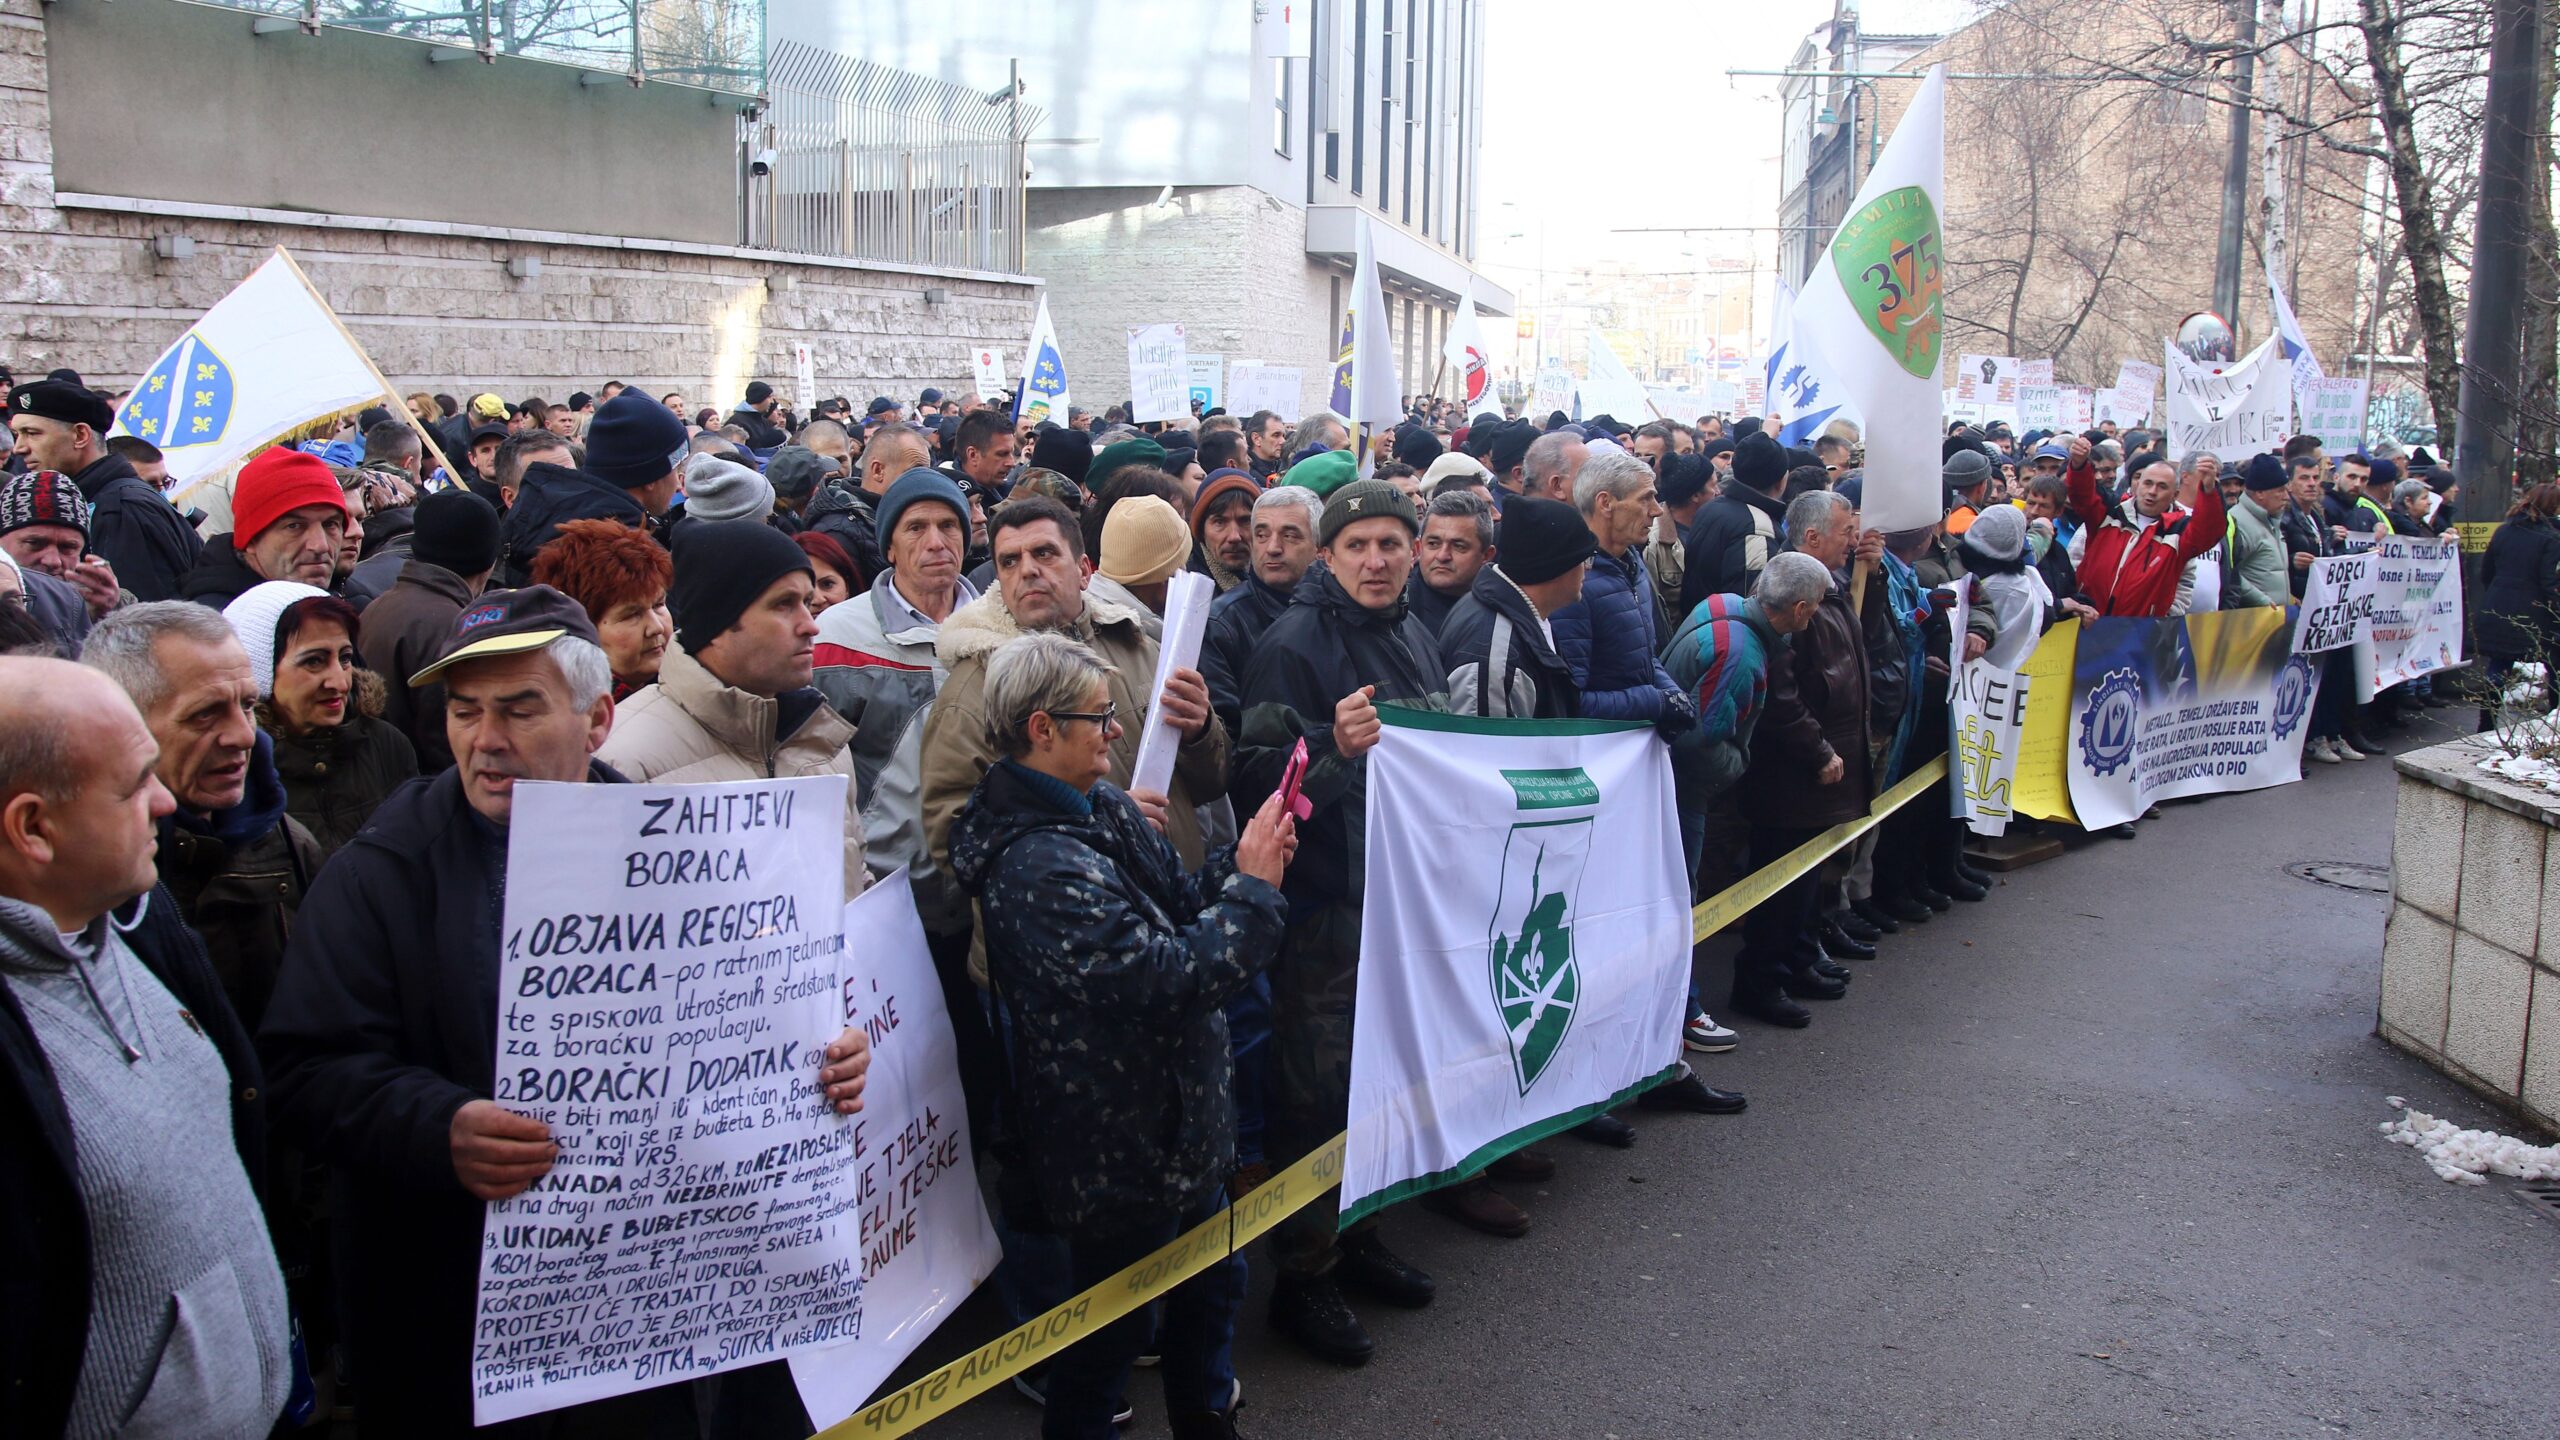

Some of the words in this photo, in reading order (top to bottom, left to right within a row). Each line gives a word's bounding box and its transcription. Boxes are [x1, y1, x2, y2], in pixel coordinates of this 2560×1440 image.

[1860, 232, 1940, 313] 375
[2020, 389, 2060, 400] UZMITE
[2326, 558, 2366, 585] BORCI
[2309, 593, 2375, 629] CAZINSKE
[2337, 583, 2350, 604] IZ
[2302, 622, 2356, 651] KRAJINE
[2206, 699, 2240, 718] DRŽAVE
[2240, 701, 2259, 716] BIH
[2238, 720, 2266, 735] RATA
[2216, 761, 2224, 775] O
[2226, 760, 2247, 776] PIO
[640, 790, 795, 837] ZAHTJEVI
[625, 848, 750, 887] BORACA
[529, 912, 665, 957] OBJAVA
[678, 895, 799, 949] REGISTRA
[713, 946, 782, 979] ratnim
[504, 1002, 535, 1032] te
[550, 1005, 663, 1039] spiskova
[677, 975, 764, 1022] utrošenih
[773, 968, 837, 1004] sredstava
[506, 1039, 540, 1057] za
[666, 1016, 771, 1061] populaciju.
[686, 1040, 799, 1095] DODATAK
[566, 1106, 601, 1126] biti
[671, 1097, 690, 1119] ili
[596, 1131, 632, 1156] koji
[639, 1129, 659, 1149] se
[882, 1106, 940, 1177] TJELA
[630, 1169, 651, 1190] od
[900, 1129, 960, 1210] TEŠKE
[519, 1198, 542, 1215] na
[548, 1194, 595, 1223] drugi
[663, 1171, 788, 1204] NEZBRINUTE
[506, 1271, 577, 1296] potrebe
[479, 1304, 590, 1339] PROTESTI
[632, 1283, 716, 1314] TRAJATI
[728, 1280, 755, 1299] DO
[590, 1319, 634, 1344] OVO
[638, 1314, 666, 1335] JE
[671, 1302, 734, 1329] BITKA
[740, 1298, 763, 1316] ZA
[769, 1276, 864, 1312] DOSTOJANSTVO
[578, 1337, 644, 1362] PROTIV
[648, 1324, 708, 1350] RATNIH
[715, 1310, 798, 1335] PROFITERA
[542, 1357, 628, 1385] POLITIČARA
